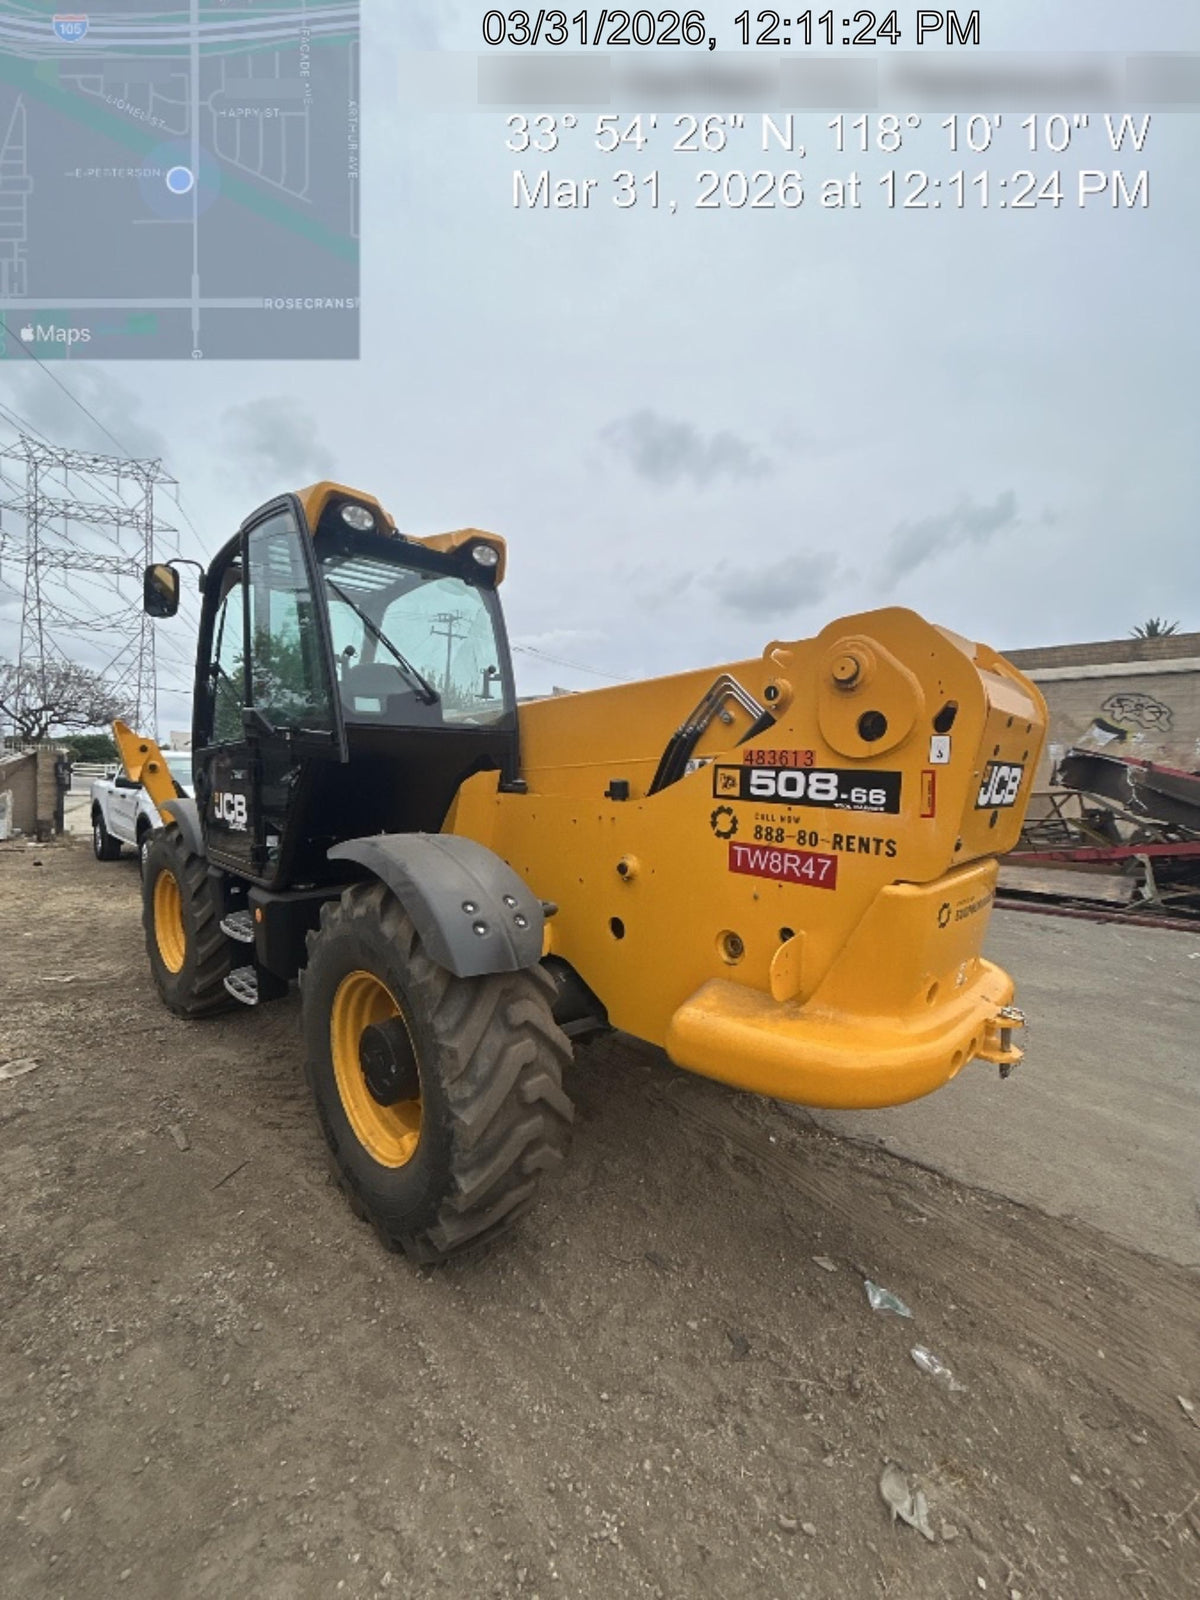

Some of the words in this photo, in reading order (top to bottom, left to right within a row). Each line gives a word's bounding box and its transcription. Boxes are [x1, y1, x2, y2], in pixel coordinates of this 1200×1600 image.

[744, 750, 814, 767] 483613
[978, 765, 1023, 806] JCB
[214, 792, 248, 824] JCB
[753, 825, 897, 858] 888-80-RENTS
[732, 845, 832, 881] TW8R47
